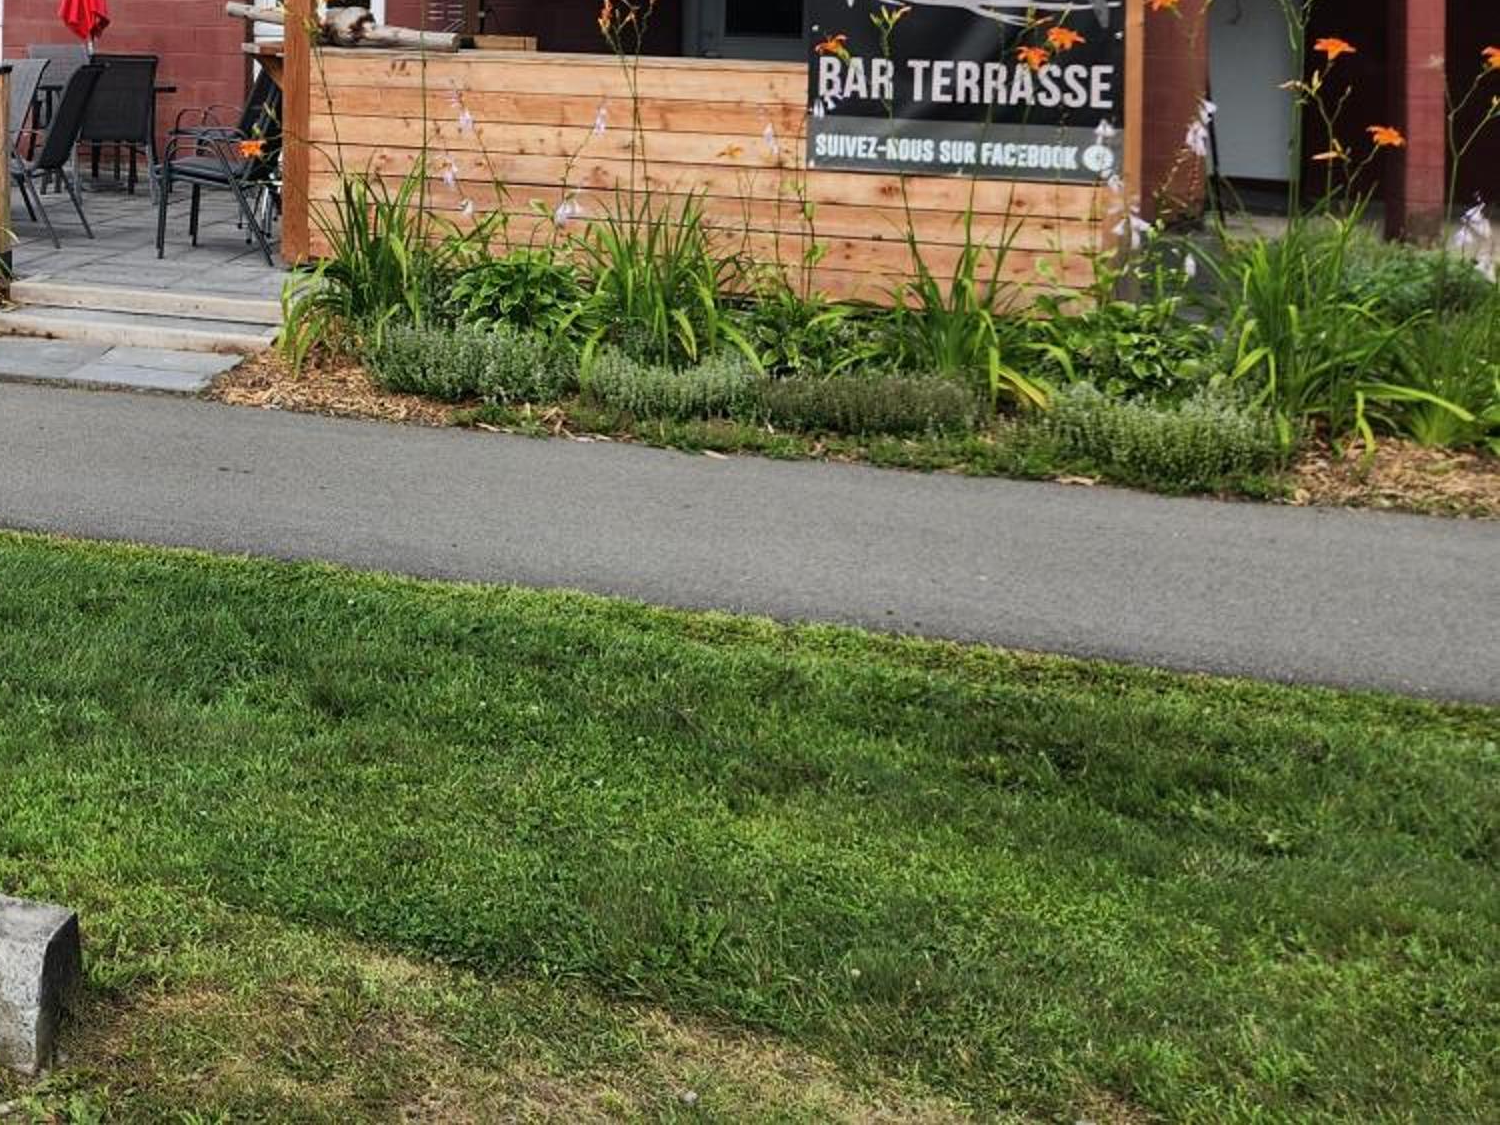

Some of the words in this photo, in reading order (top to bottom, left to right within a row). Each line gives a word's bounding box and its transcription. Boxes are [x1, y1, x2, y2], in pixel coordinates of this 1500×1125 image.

[818, 55, 894, 100] BAR
[908, 59, 1114, 108] TERRASSE
[815, 133, 934, 163] SUIVEZ-NOUS
[940, 139, 976, 164] SUR
[981, 142, 1078, 170] FACEBOOK
